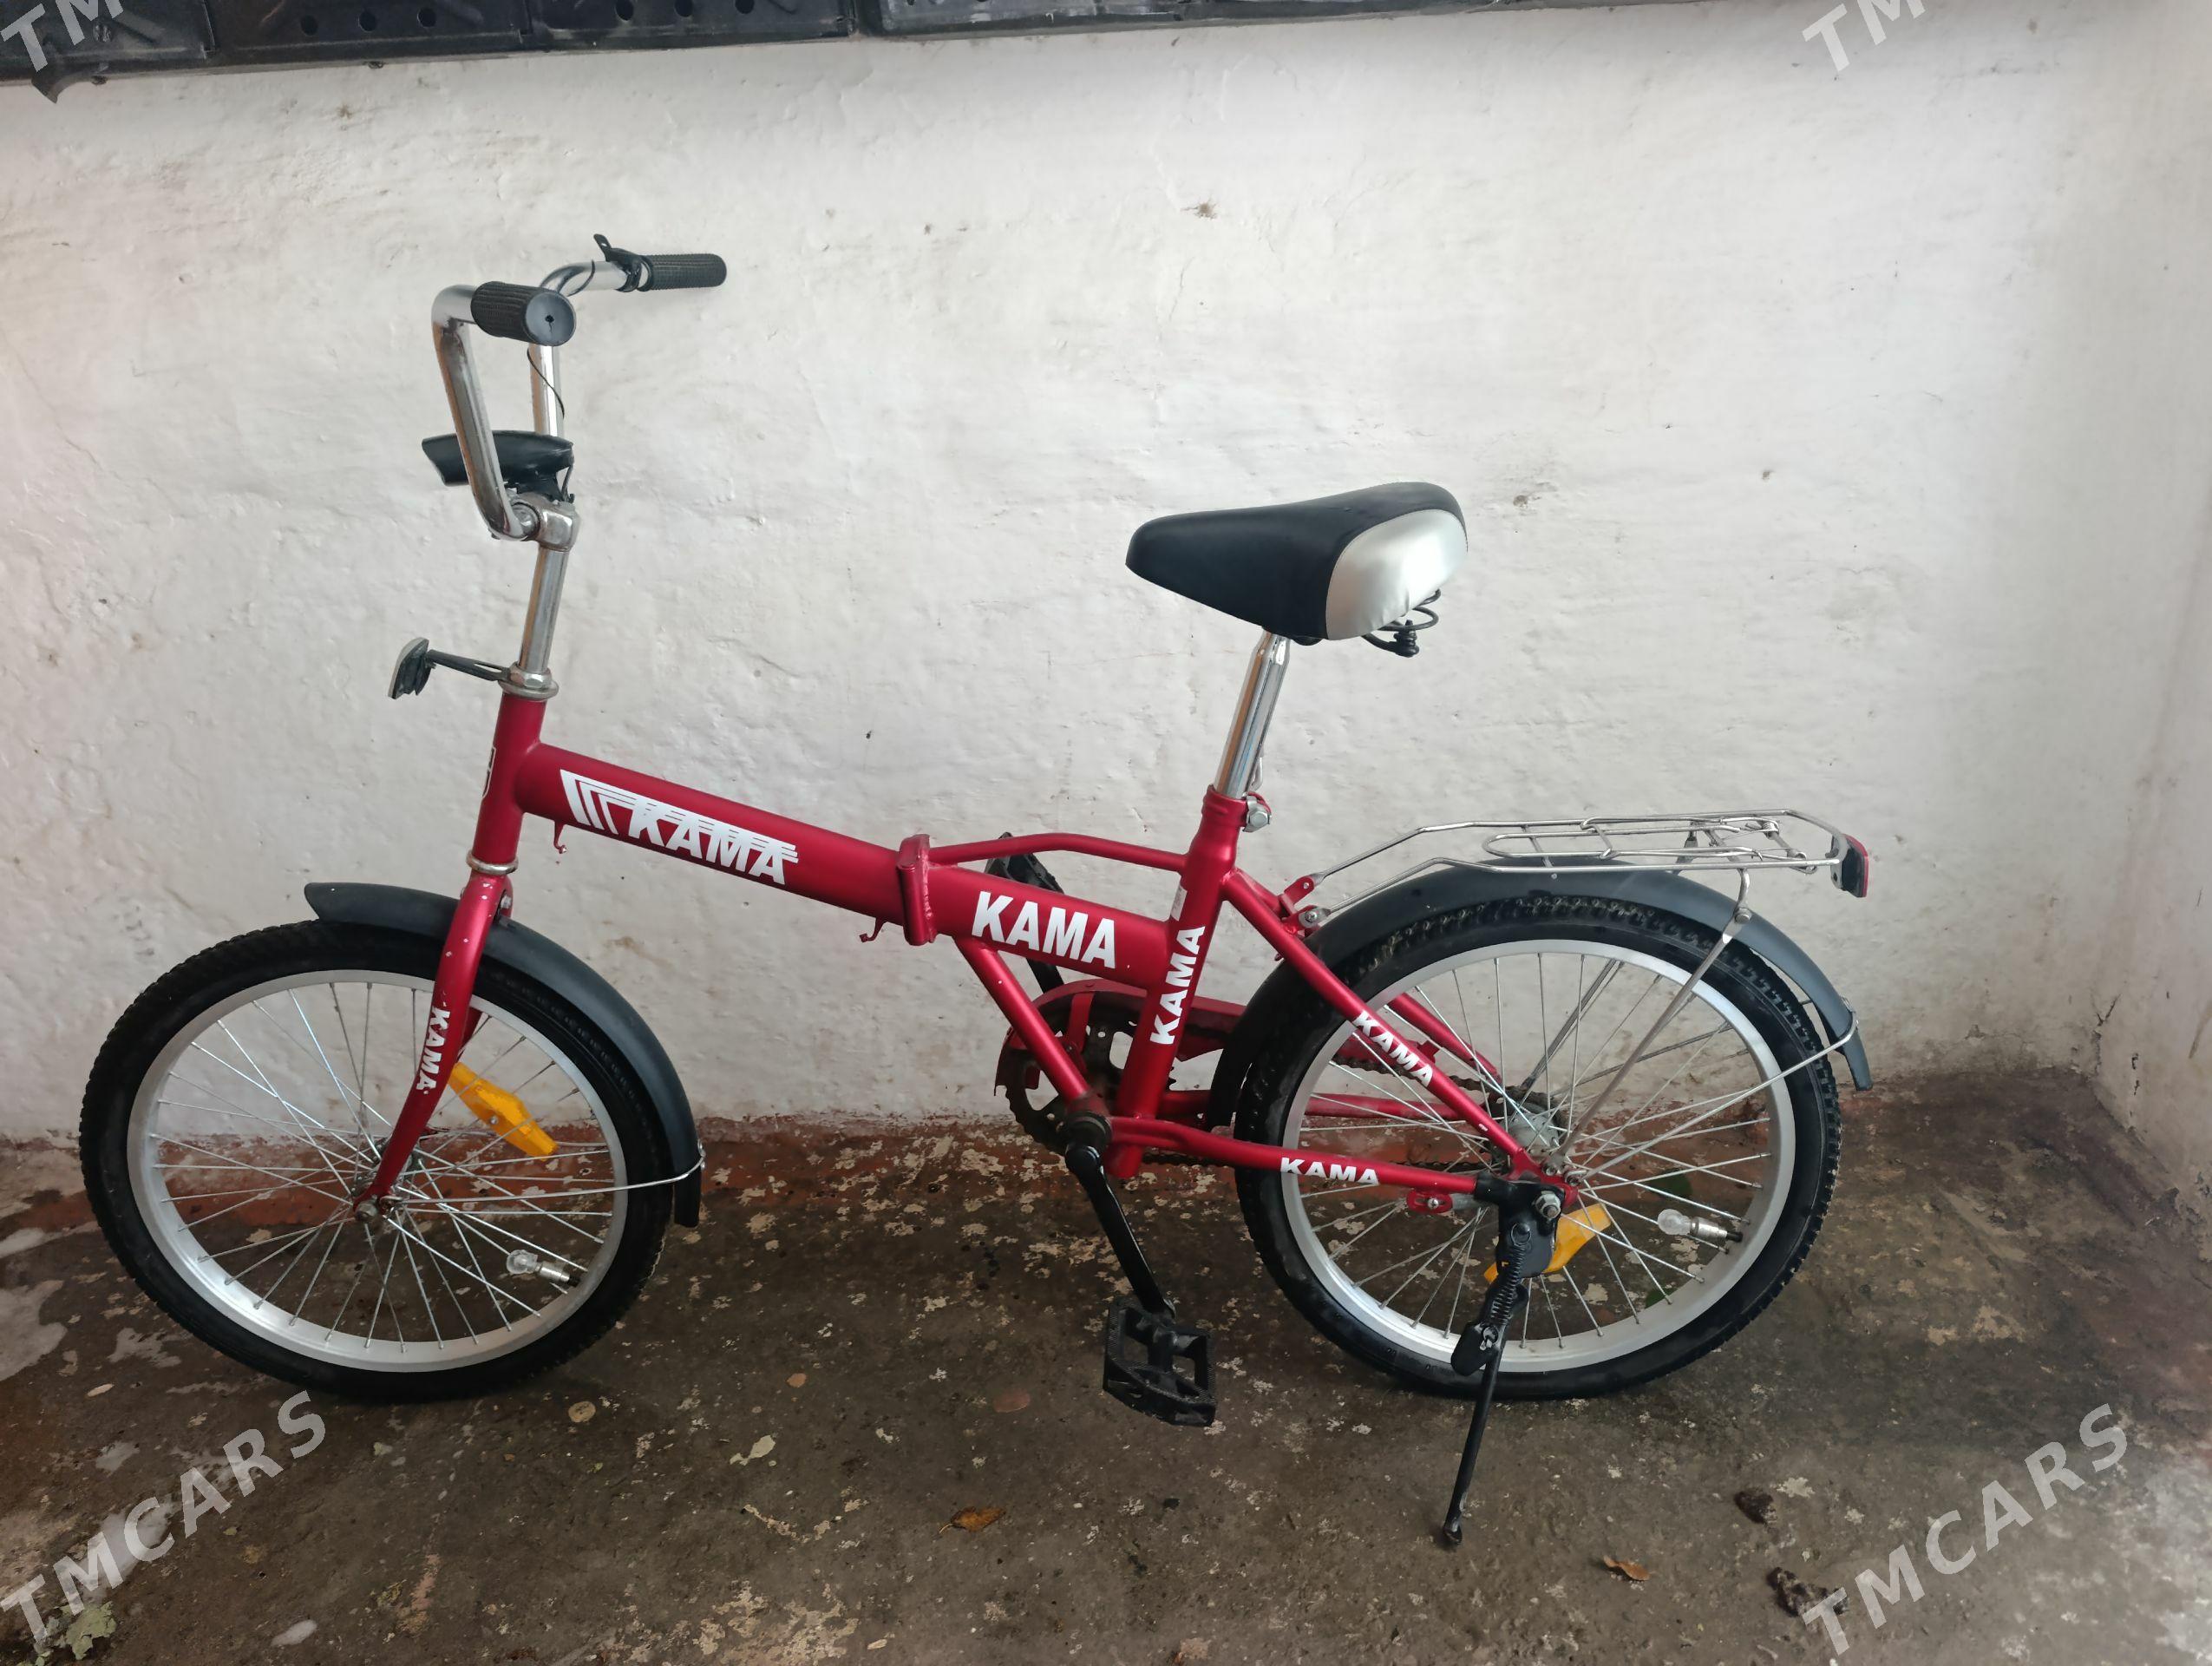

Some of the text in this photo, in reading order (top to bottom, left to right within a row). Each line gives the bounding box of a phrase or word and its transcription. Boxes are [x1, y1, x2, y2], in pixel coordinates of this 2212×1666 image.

[627, 793, 786, 885] KAMA
[972, 890, 1116, 969] KAMA
[1149, 925, 1206, 1045] KAMA
[416, 1006, 451, 1091] KAMA
[1352, 1010, 1433, 1087] KAMA
[1280, 1157, 1380, 1186] KAMA
